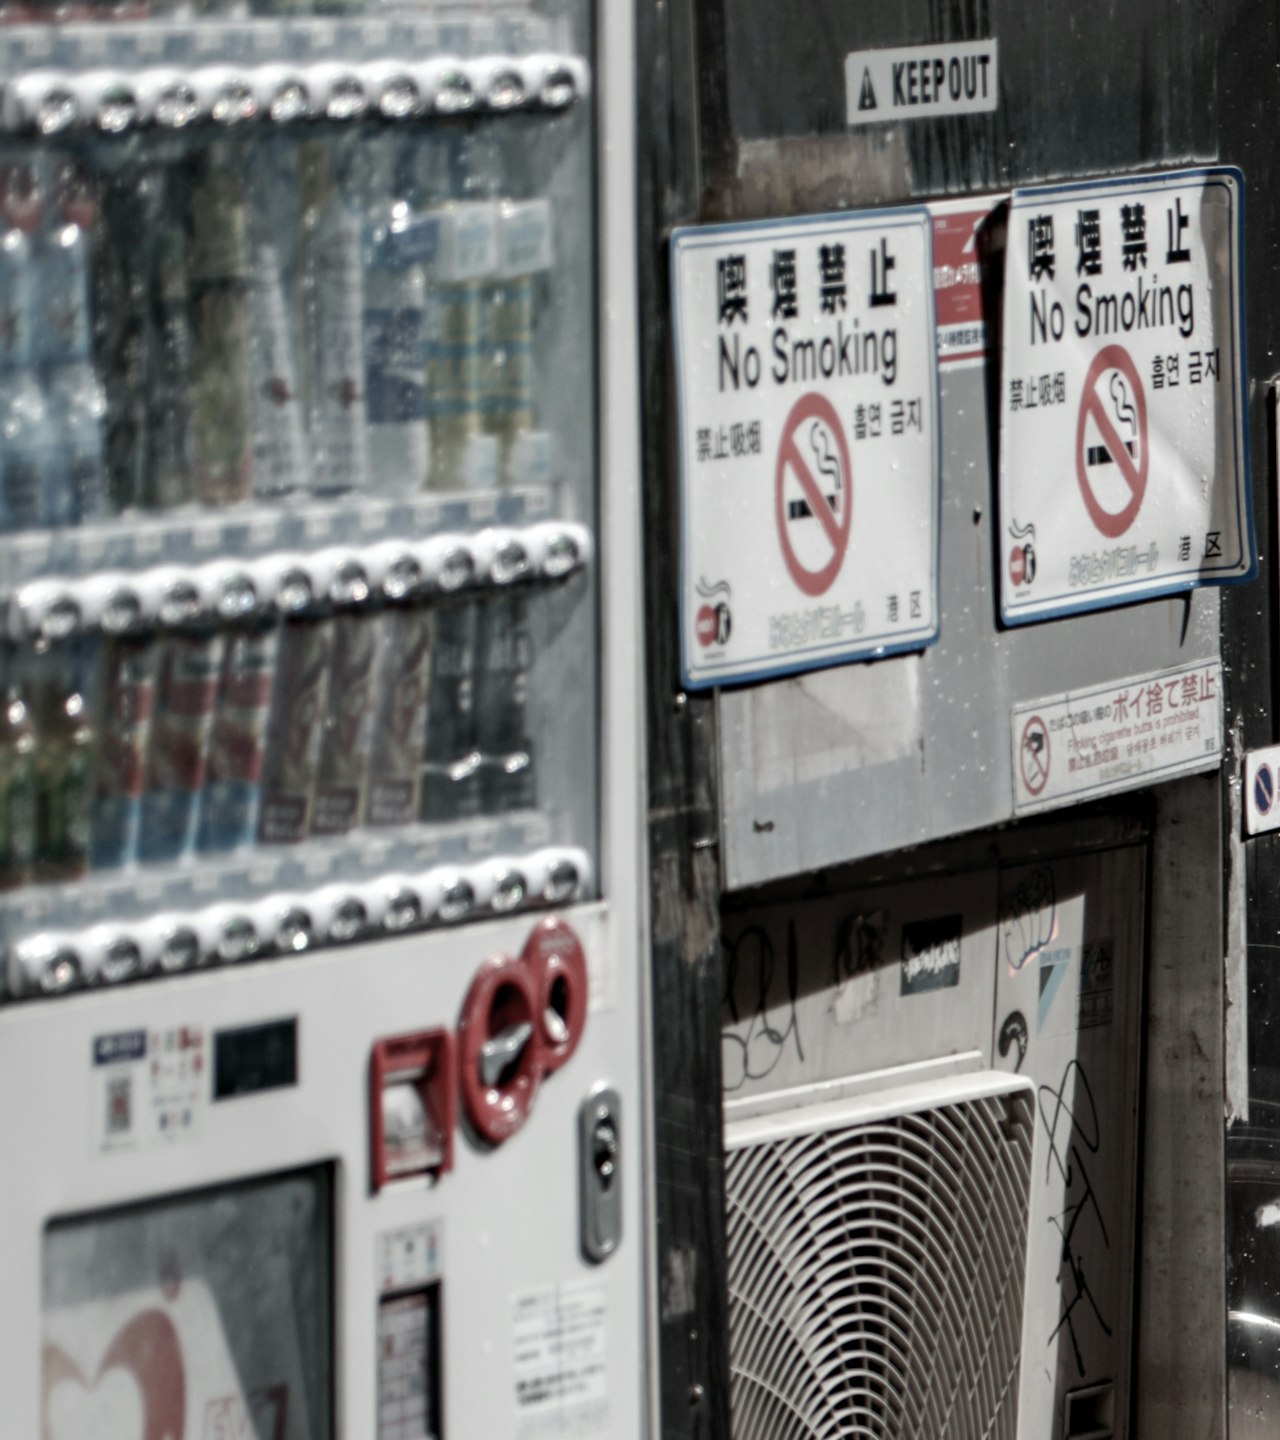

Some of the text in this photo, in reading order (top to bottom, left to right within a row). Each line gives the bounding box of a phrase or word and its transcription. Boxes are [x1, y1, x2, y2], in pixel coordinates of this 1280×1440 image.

[892, 54, 990, 106] KEEP OUT
[1028, 197, 1190, 283] 喫煙禁止
[716, 237, 897, 327] 喫煙禁止
[1030, 274, 1195, 346] No Smoking
[716, 318, 897, 392] No Smoking
[1188, 347, 1220, 384] 금지
[890, 397, 922, 435] 금지
